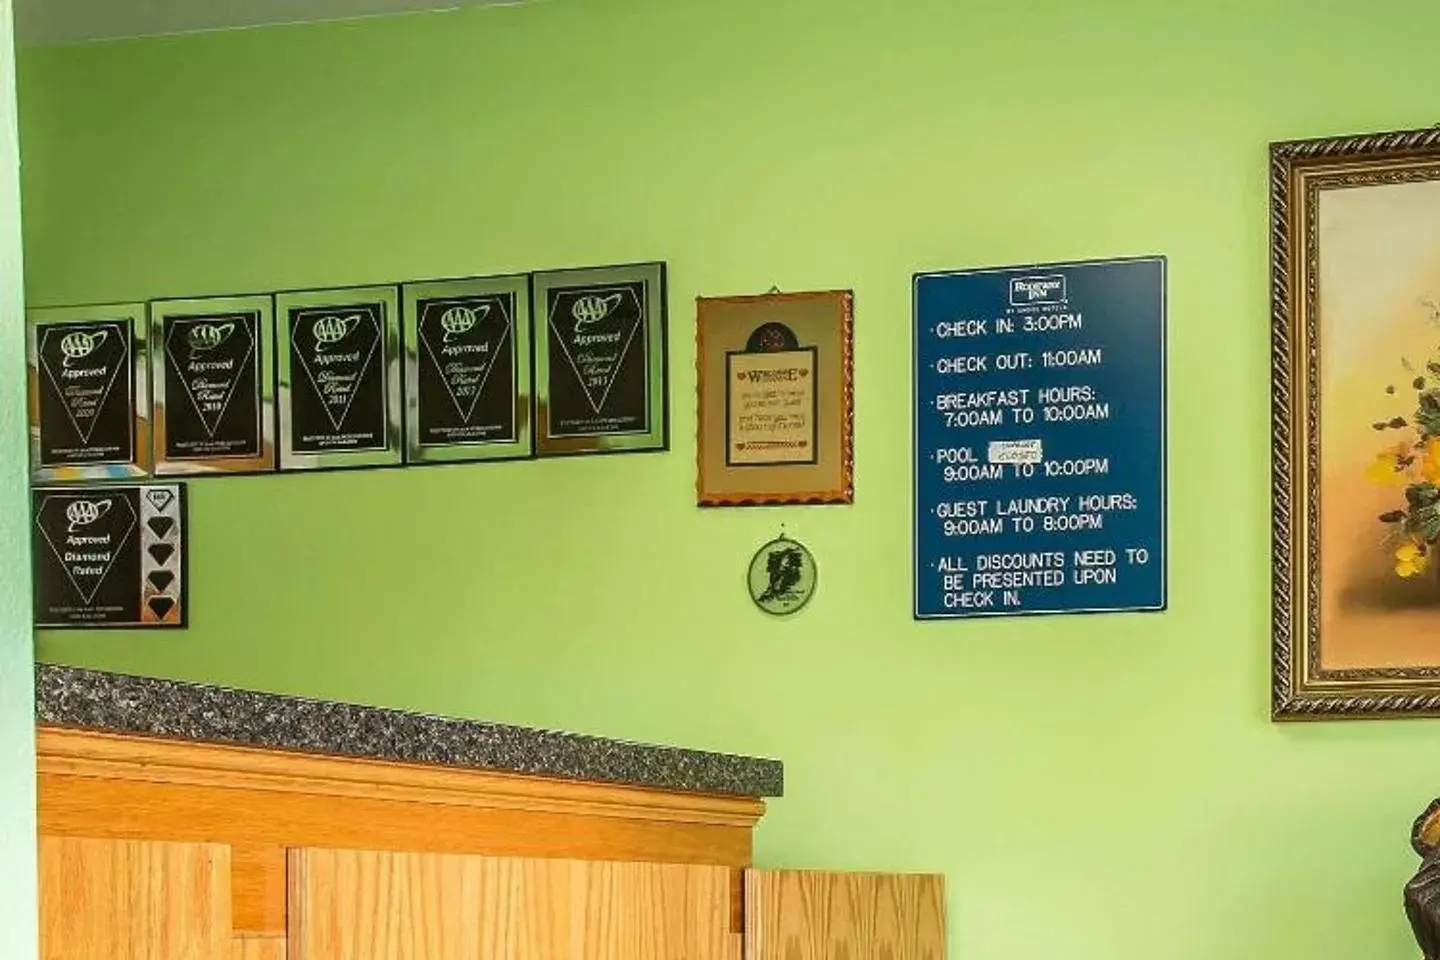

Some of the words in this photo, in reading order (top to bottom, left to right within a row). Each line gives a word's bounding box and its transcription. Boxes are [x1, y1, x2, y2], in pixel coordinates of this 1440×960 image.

[936, 320, 987, 338] CHECK
[995, 318, 1015, 334] IN:
[1022, 314, 1082, 332] 3:00PM
[574, 331, 621, 346] Approved
[314, 351, 360, 364] Approved
[441, 342, 489, 357] Approved
[188, 360, 234, 372] Approved
[936, 357, 987, 373] CHECK
[996, 353, 1033, 370] OUT:
[1042, 349, 1102, 367] 11:00AM
[61, 366, 107, 380] Approved
[936, 390, 1030, 411] BREAKFAST
[1038, 386, 1096, 403] HOURS:
[944, 409, 1001, 428] 7:00AM
[1012, 408, 1034, 425] TO
[1044, 404, 1110, 422] 10:00AM
[936, 448, 979, 464] POOL
[944, 463, 1002, 482] 9:00AM
[1014, 463, 1034, 477] TO
[1044, 458, 1109, 476] 10:00PM
[936, 501, 988, 518] GUEST
[997, 497, 1070, 515] LAUNDRY
[1079, 494, 1138, 511] HOURS:
[944, 519, 1002, 536] 9:00AM
[1012, 518, 1034, 533] TO
[1043, 513, 1103, 531] 8:00PM
[66, 534, 111, 546] Approved
[64, 552, 111, 562] Diamond
[938, 555, 968, 572] ALL
[977, 552, 1065, 570] DISCOUNTS
[1074, 549, 1116, 566] NEED
[1127, 548, 1149, 565] TO
[72, 566, 103, 576] Rated
[944, 574, 964, 591] BE
[972, 570, 1065, 589] PRESENTED
[1073, 567, 1117, 585] UPON
[944, 591, 994, 608] CHECK
[1003, 589, 1022, 606] IN.
